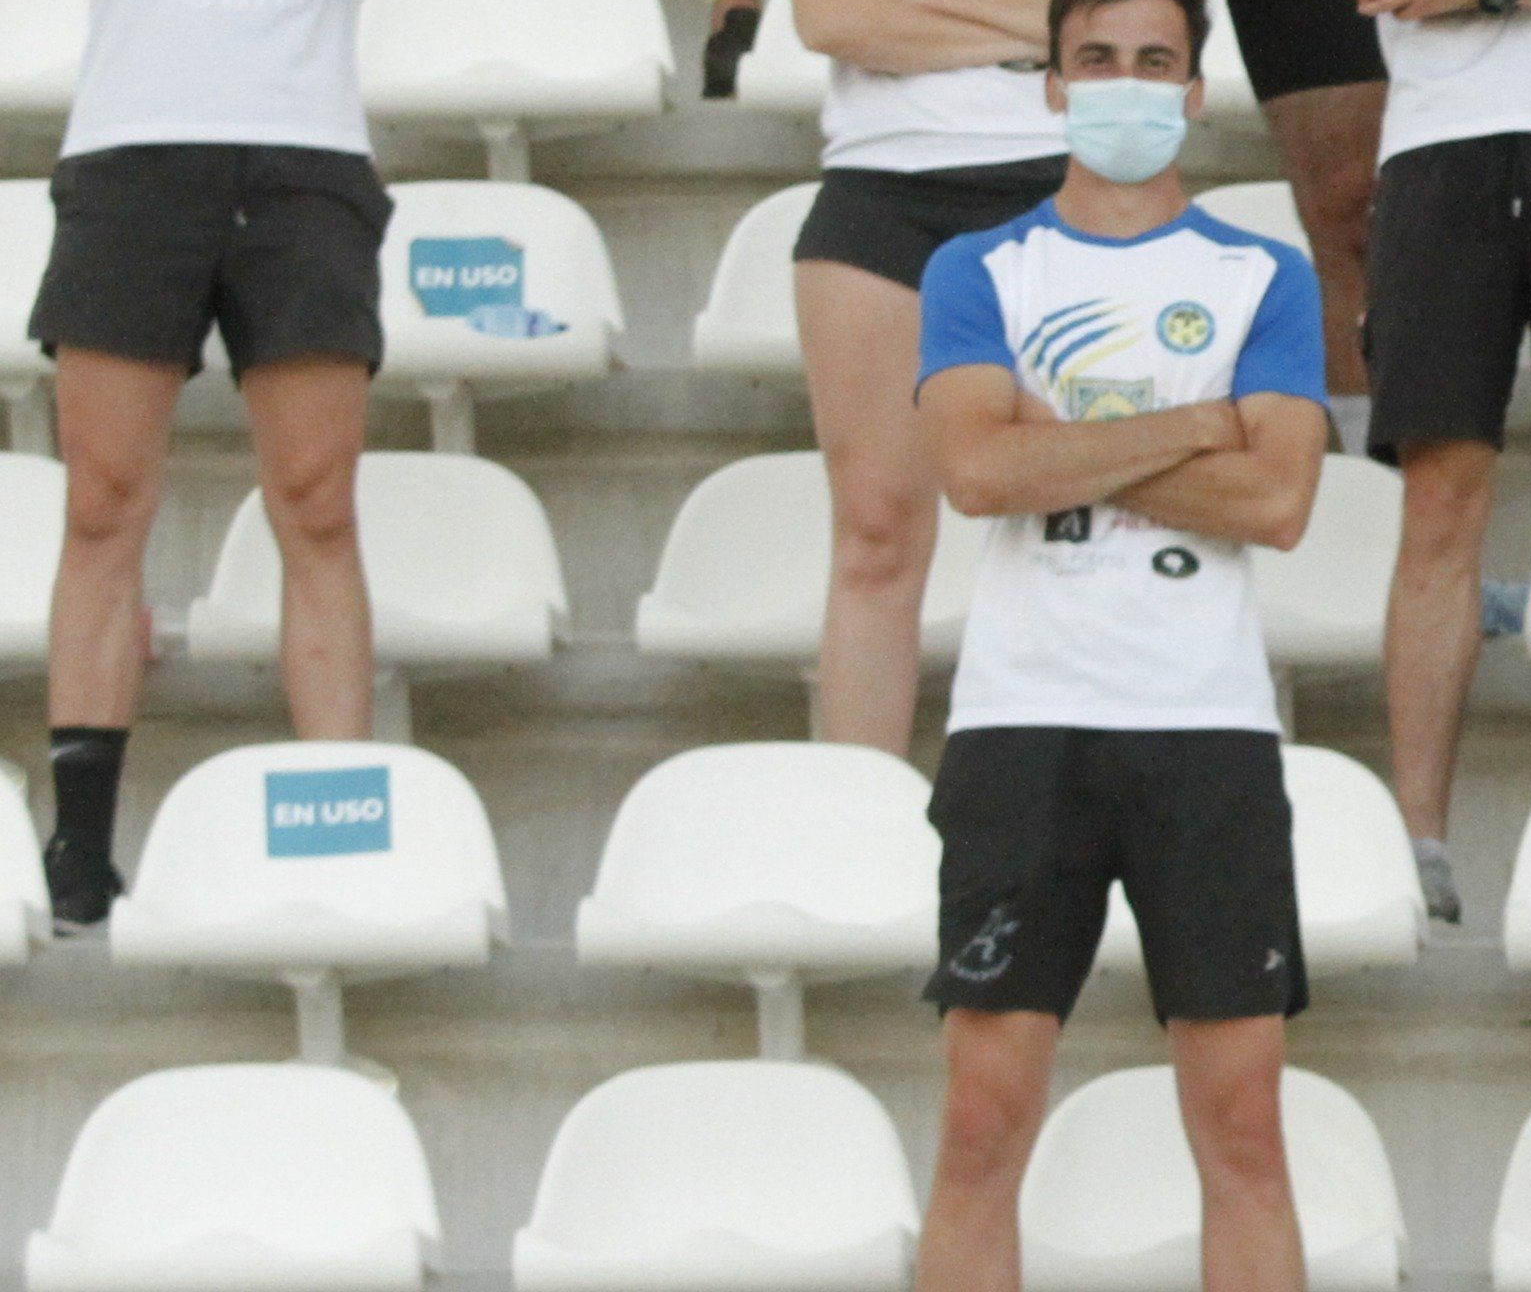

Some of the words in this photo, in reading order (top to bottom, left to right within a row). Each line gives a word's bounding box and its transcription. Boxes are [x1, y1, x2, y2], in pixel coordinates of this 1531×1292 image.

[416, 266, 454, 288] EN
[460, 265, 517, 288] USO
[274, 802, 315, 827] EN
[322, 797, 384, 824] USO
